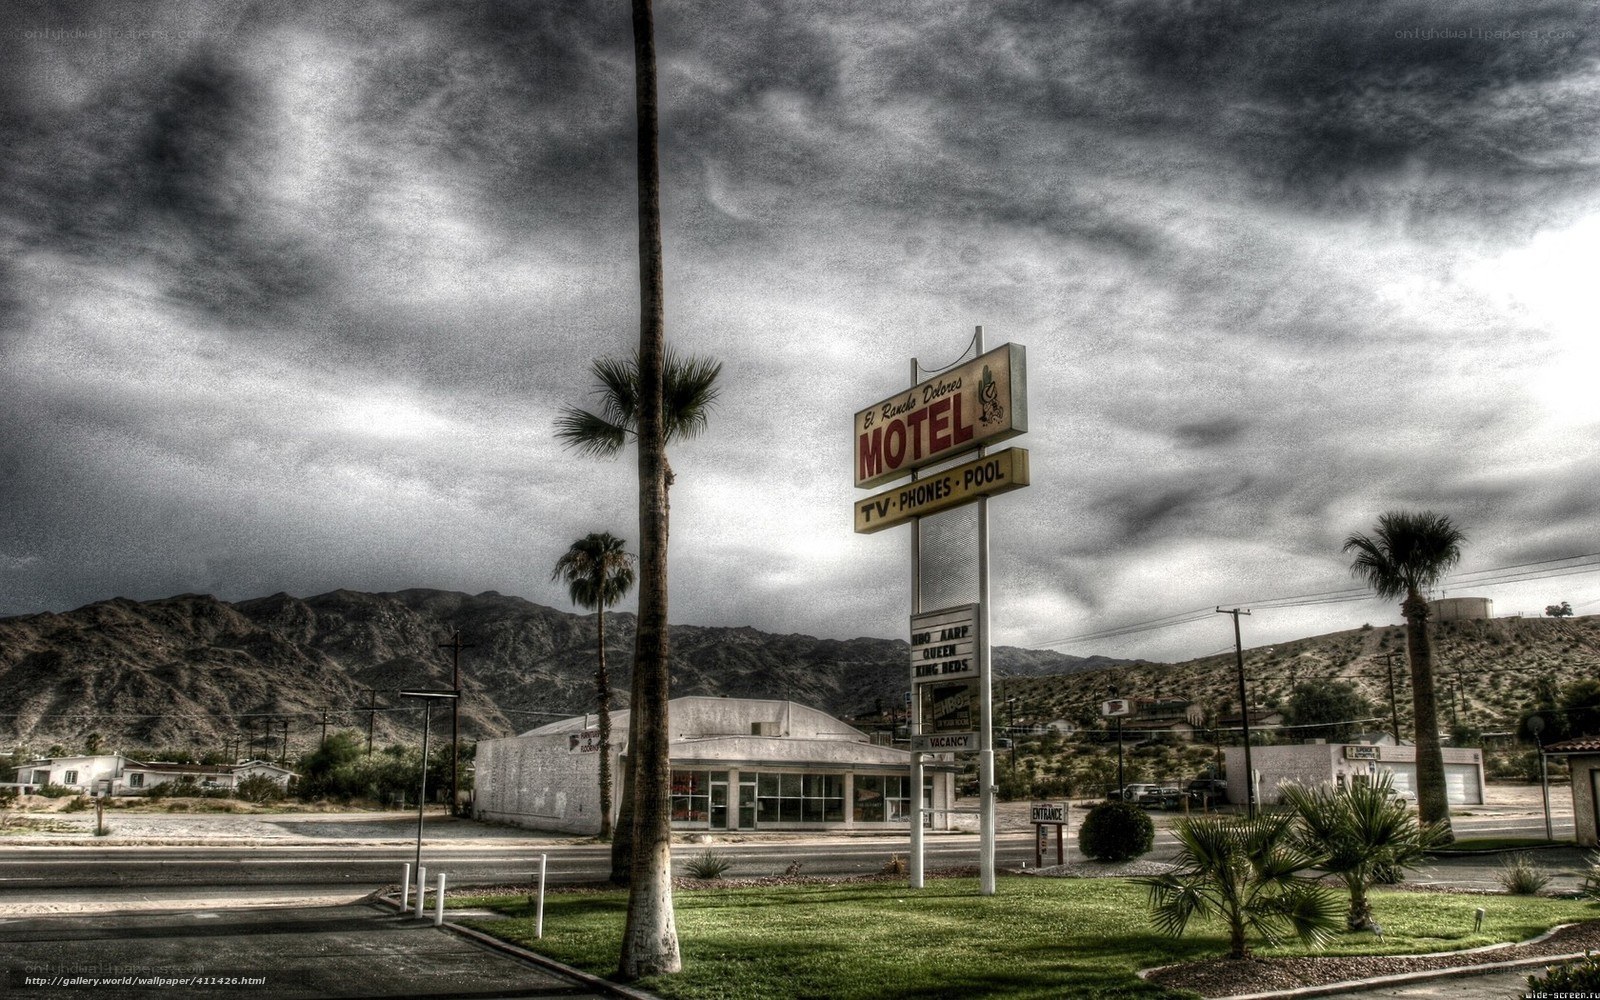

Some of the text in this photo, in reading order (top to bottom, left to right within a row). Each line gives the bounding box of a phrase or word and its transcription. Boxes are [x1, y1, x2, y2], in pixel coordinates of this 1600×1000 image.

[864, 377, 962, 430] El Rancho Delores
[859, 392, 974, 481] MOTEL
[861, 459, 1004, 522] TV PHONES POOL
[912, 626, 968, 646] HBO AARP
[923, 645, 956, 659] QUEEN
[916, 658, 968, 677] KING BEDS
[930, 736, 968, 748] VACANCY
[1033, 808, 1062, 820] ENTRANCE
